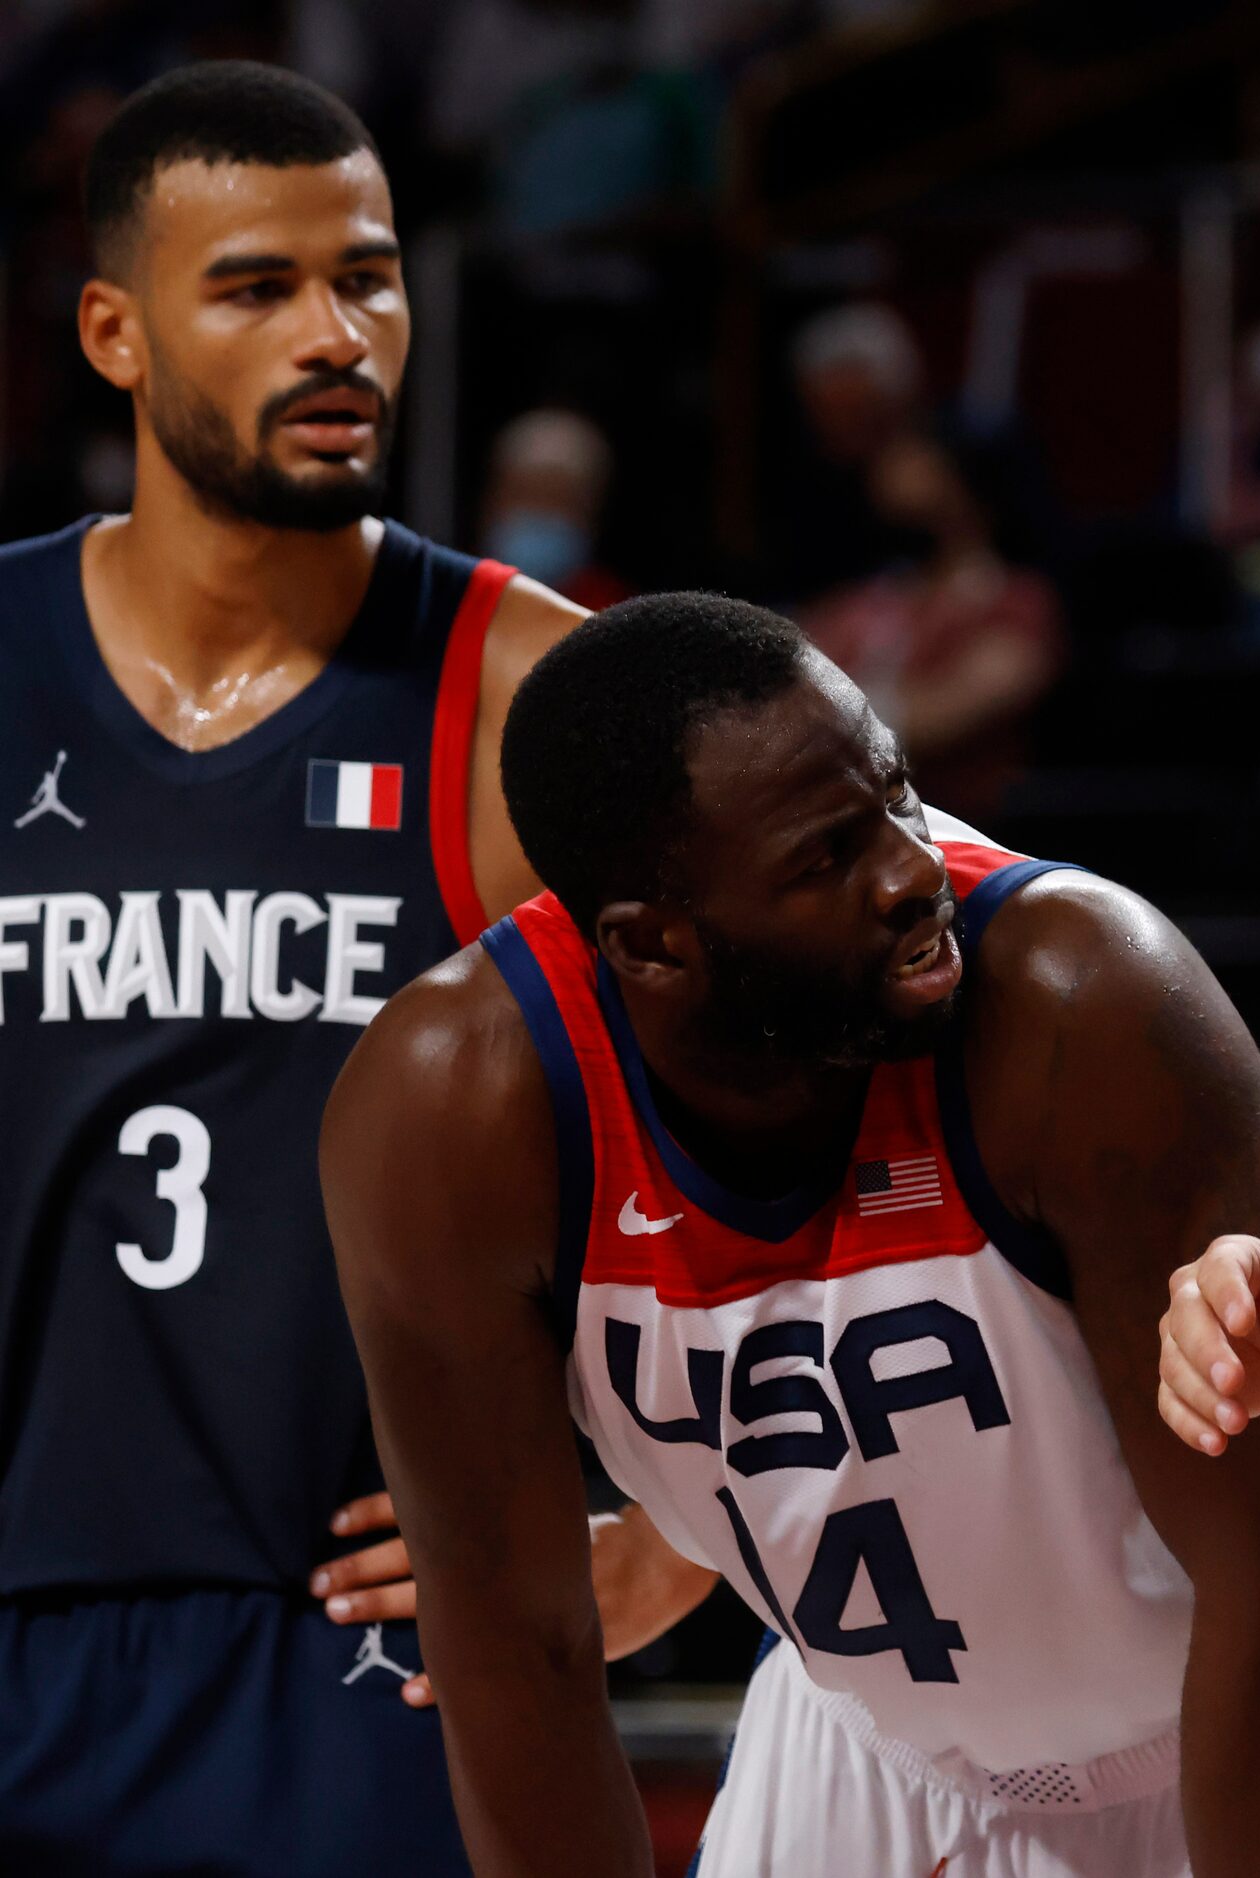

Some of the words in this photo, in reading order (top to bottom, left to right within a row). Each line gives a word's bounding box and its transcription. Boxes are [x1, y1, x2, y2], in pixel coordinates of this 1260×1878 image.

[0, 889, 403, 1027] FRANCE
[116, 1105, 211, 1290] 3
[605, 1299, 1011, 1477] USA
[715, 1486, 968, 1684] 14
